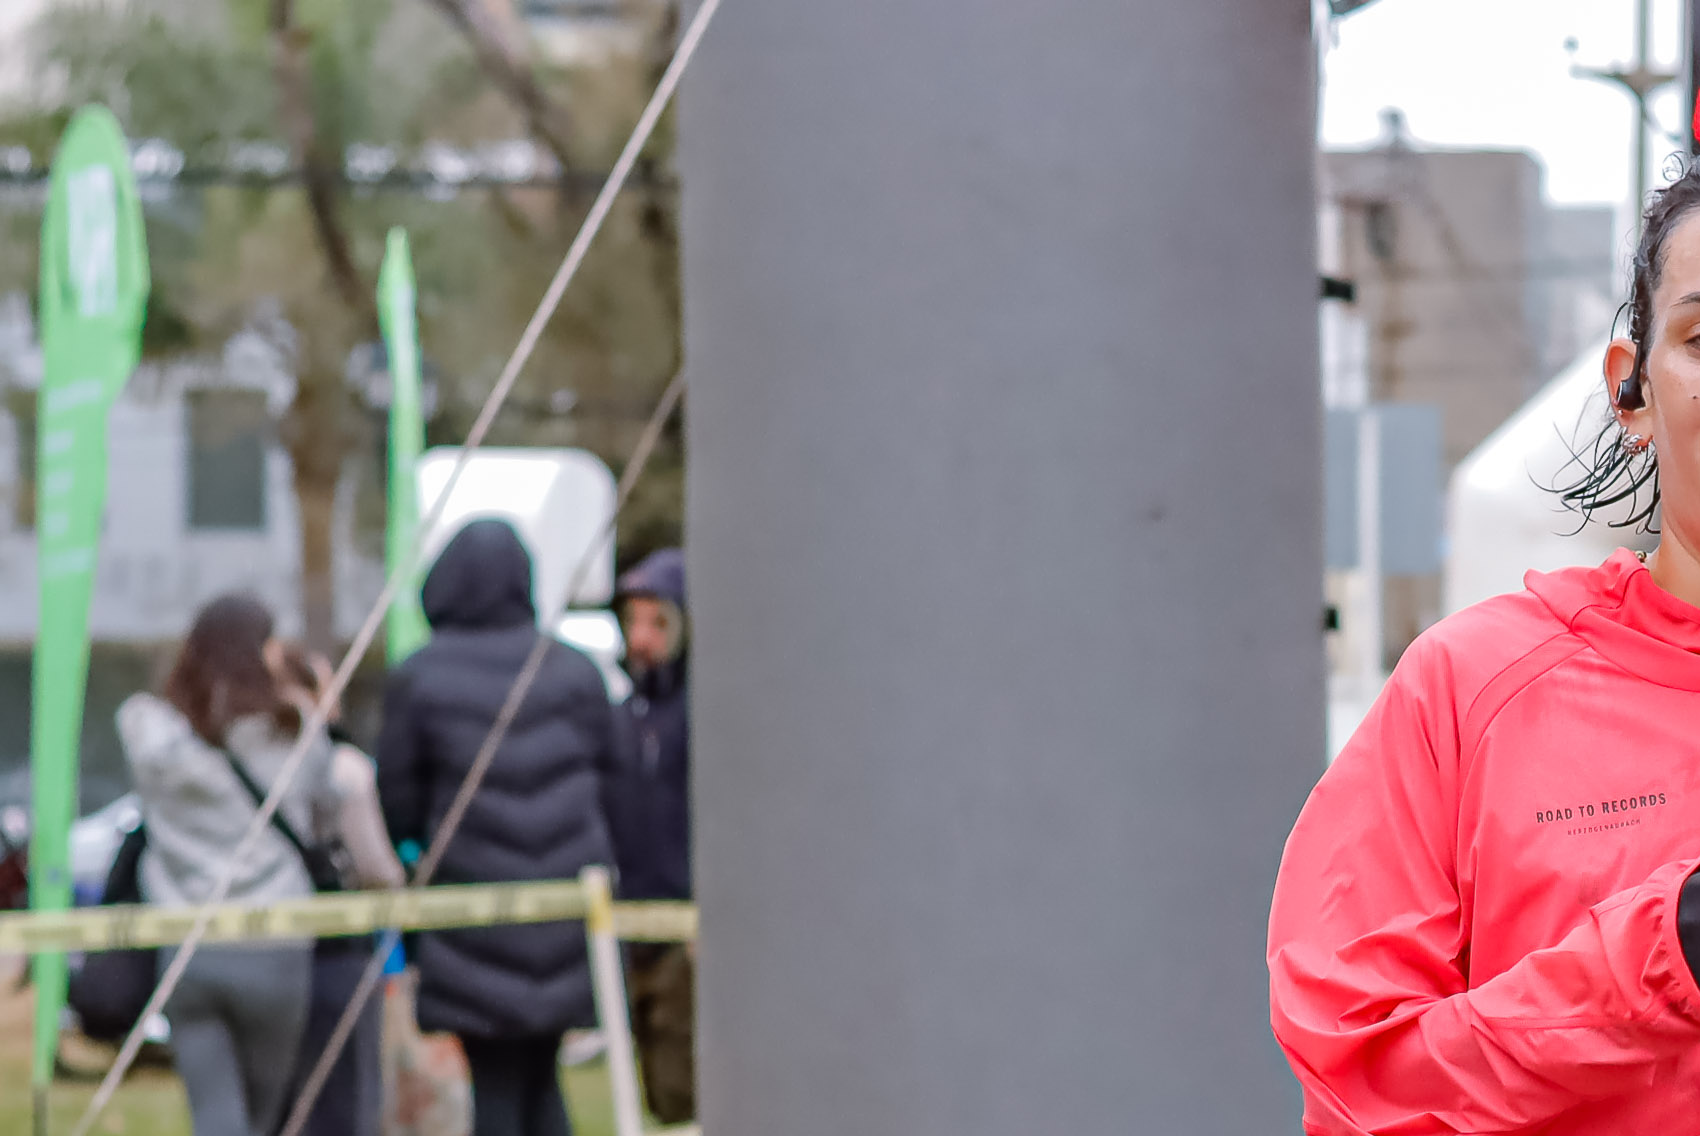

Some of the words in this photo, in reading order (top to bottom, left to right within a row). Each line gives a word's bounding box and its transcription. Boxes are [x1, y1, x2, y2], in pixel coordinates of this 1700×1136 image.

[1536, 808, 1573, 823] ROAD
[1578, 804, 1595, 818] TO
[1601, 792, 1667, 814] RECORDS
